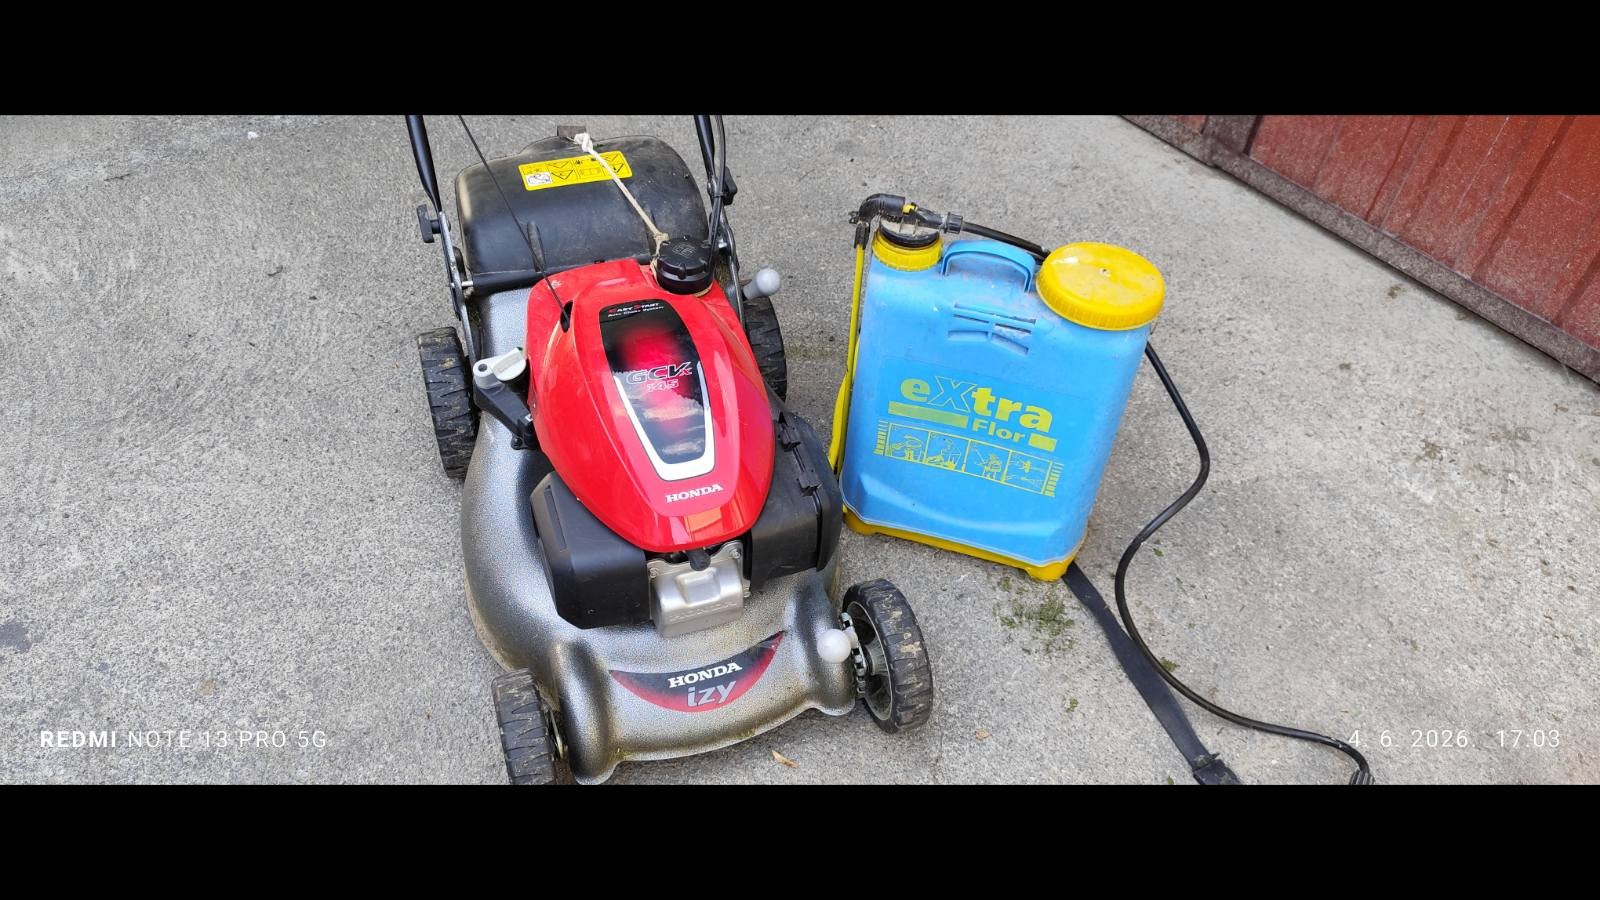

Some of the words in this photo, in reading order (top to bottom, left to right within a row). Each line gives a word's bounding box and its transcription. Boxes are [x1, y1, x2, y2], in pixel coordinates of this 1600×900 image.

[971, 418, 1026, 443] Flor
[665, 483, 723, 503] HONDA
[668, 661, 743, 688] HONDA
[686, 680, 736, 707] izy
